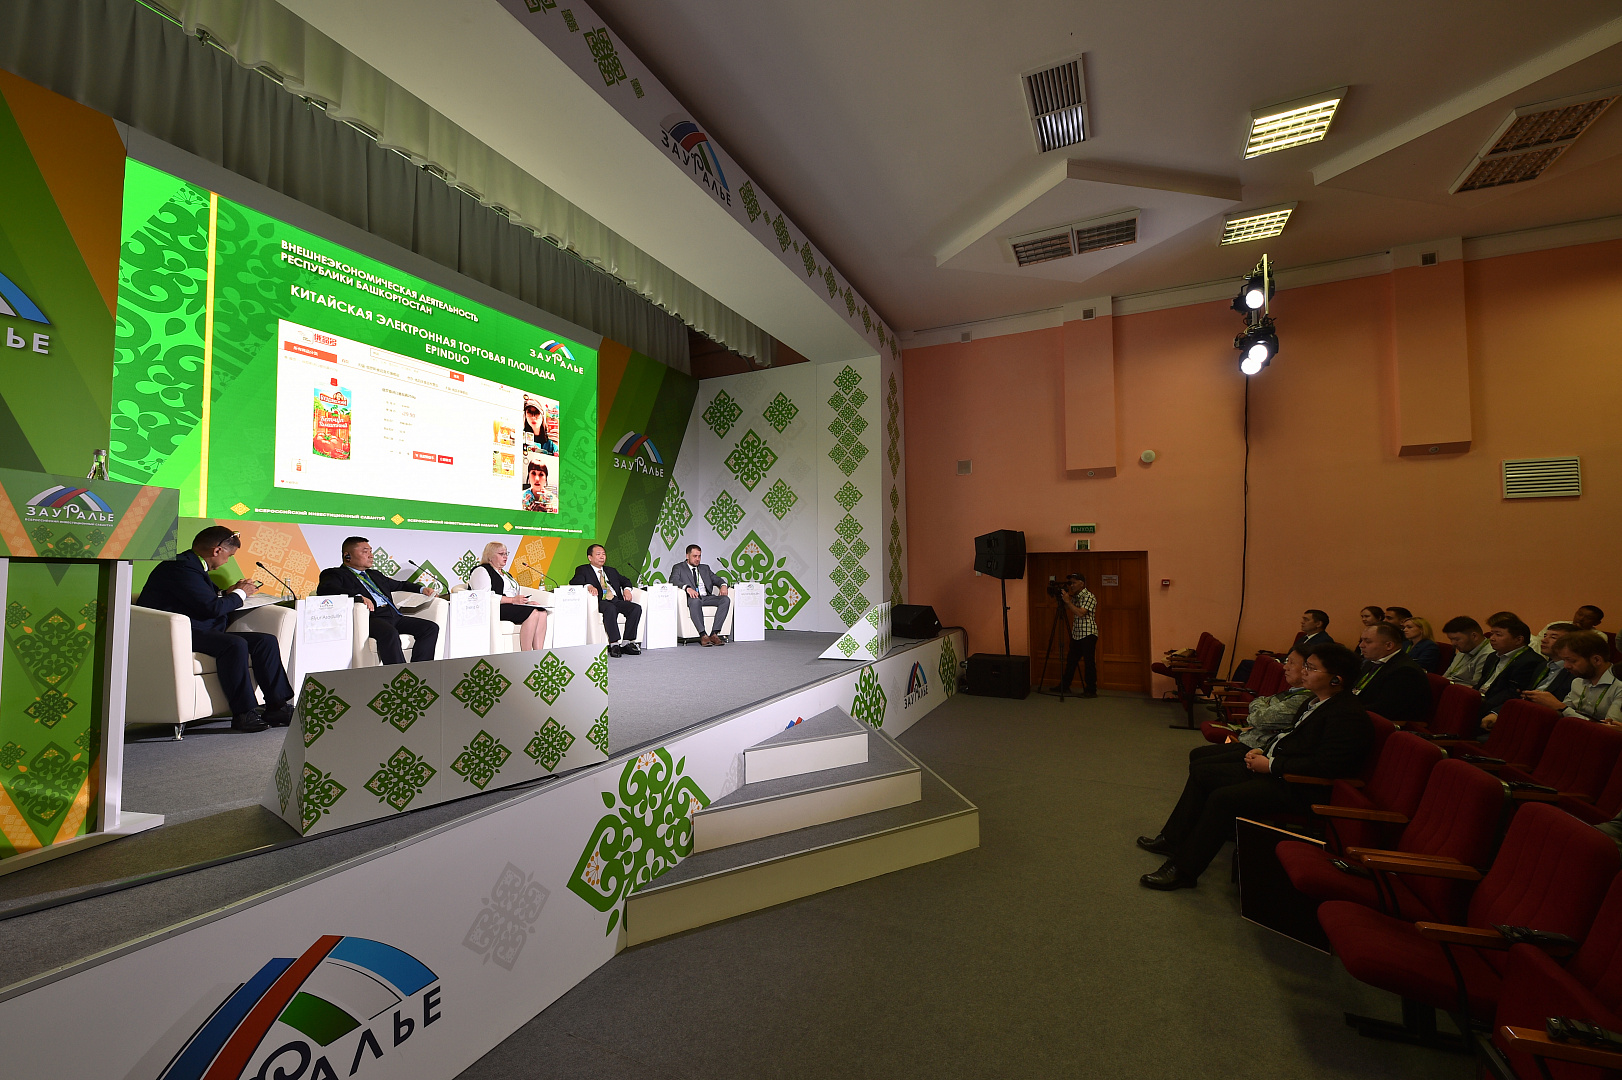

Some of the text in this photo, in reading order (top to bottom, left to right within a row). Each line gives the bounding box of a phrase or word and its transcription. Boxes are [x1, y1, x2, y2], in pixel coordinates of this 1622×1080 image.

[661, 130, 731, 207] ЗАУРАЛЬЕ
[280, 252, 432, 315] РЕСПУБЛИКИ БАШКОРТОСТАН
[281, 240, 479, 323] ВНЕШНЕЭКОНОМИЧЕСКАЯ ДЕЯТЕЛЬНОСТЬ
[290, 284, 556, 382] КИТАЙСКАЯ ЭЛЕКТРОННАЯ ТОРГОВАЯ ПЛОЩАДКА
[425, 343, 470, 365] EPINDUO
[529, 348, 584, 375] ЗАУРАЛЬЕ
[613, 456, 664, 478] ЗАУРАЛЬЕ
[25, 503, 114, 522] ЗАУРАЛЬЕ
[254, 507, 307, 516] ВСЕРОССИЙСКИЙ
